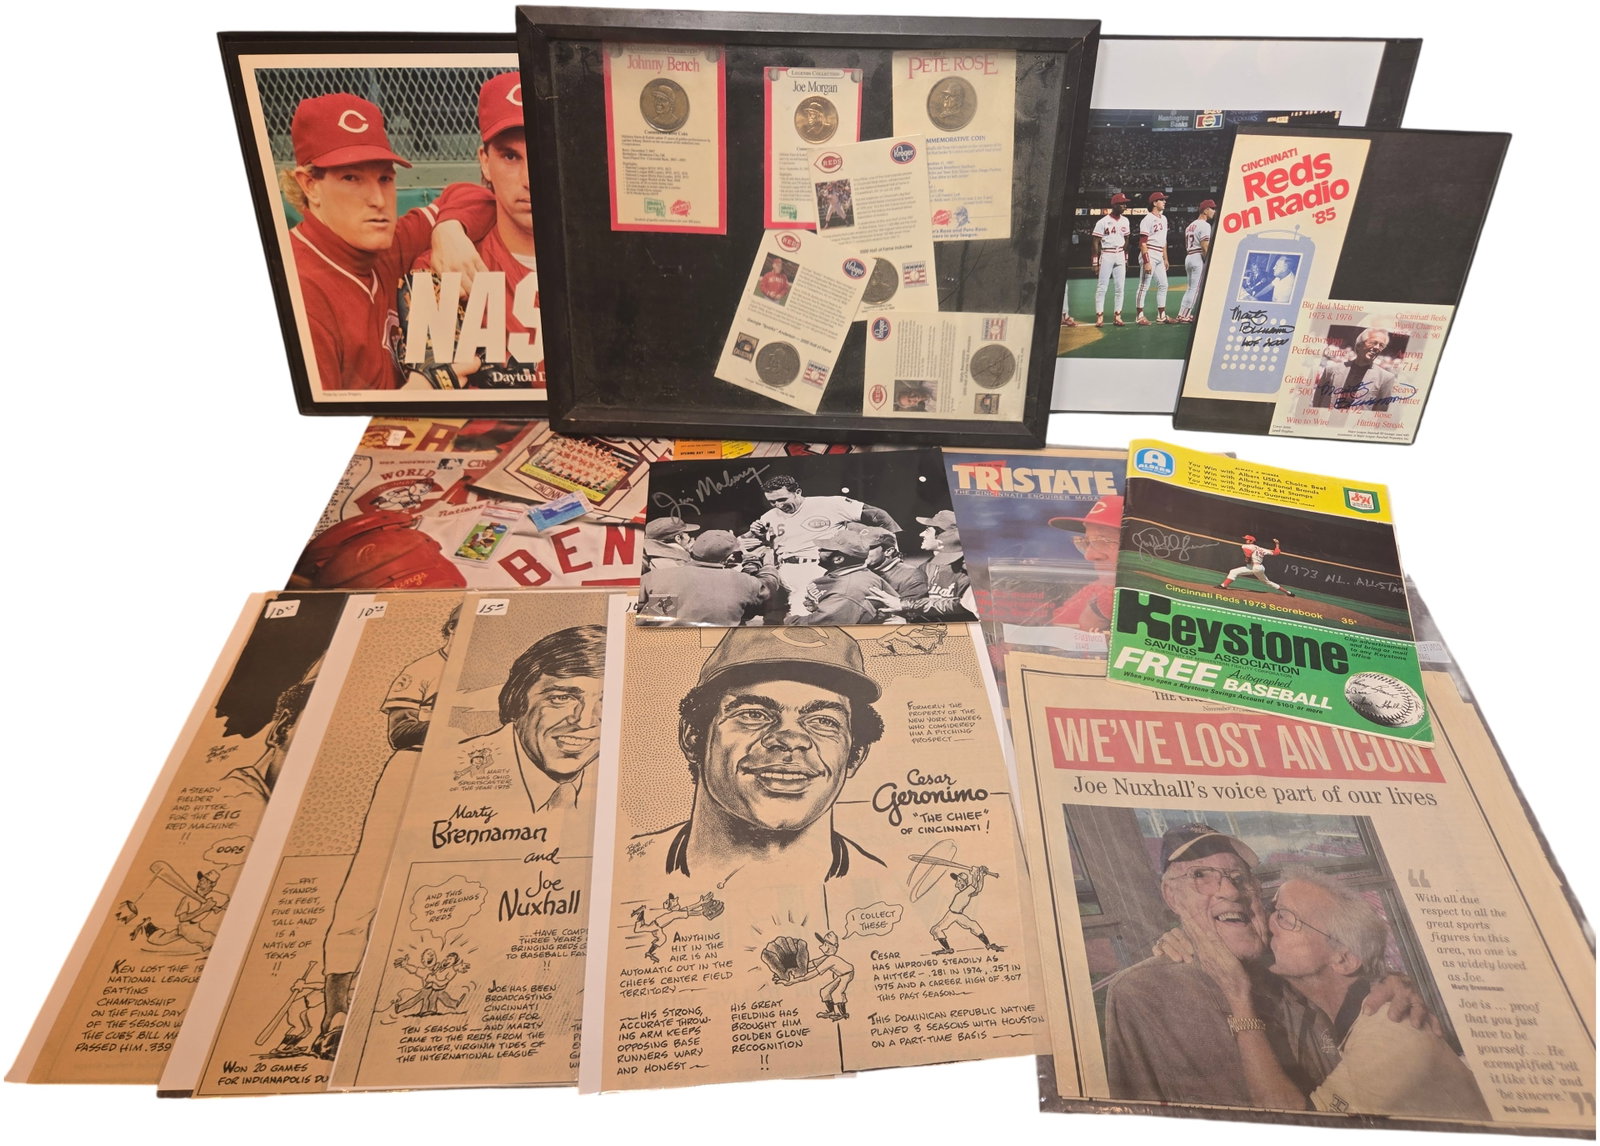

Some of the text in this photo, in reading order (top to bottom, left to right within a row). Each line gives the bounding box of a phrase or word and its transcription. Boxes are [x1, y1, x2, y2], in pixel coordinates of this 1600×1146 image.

[627, 54, 700, 74] Johnny Bench
[908, 54, 999, 80] PETE ROSE
[792, 81, 838, 95] Joe Morgan
[822, 158, 841, 166] REDS
[1241, 148, 1298, 173] CINCINNATI
[1242, 153, 1333, 202] Reds
[1223, 178, 1349, 234] on Radio
[1312, 207, 1336, 224] '85
[1104, 226, 1116, 235] 44
[1154, 223, 1163, 232] 23
[1302, 301, 1364, 311] Big Red Machine
[1309, 312, 1326, 320] 1975
[1292, 346, 1347, 357] Perfect Game
[492, 372, 537, 386] Dayton
[1285, 375, 1312, 386] Griffey
[1286, 416, 1303, 424] Wire
[1313, 417, 1329, 425] Wire
[1374, 411, 1392, 419] Rose
[1356, 419, 1404, 428] Hitting Streak
[381, 468, 436, 481] WORLD
[952, 465, 1118, 496] TRISTATE
[1263, 482, 1292, 490] National
[1296, 487, 1319, 495] Brands
[1285, 480, 1308, 488] Choice
[975, 490, 1024, 498] CINCINNATI
[1284, 564, 1319, 579] 1973
[1165, 583, 1214, 600] Cincinnati
[1216, 594, 1240, 604] Reds
[1243, 599, 1267, 610] 1973
[1269, 603, 1323, 620] Scorebook
[1116, 588, 1350, 675] Keystone
[1144, 639, 1197, 657] SAVINGS
[1113, 646, 1223, 688] FREE
[1214, 653, 1300, 676] ASSOCIATION
[1226, 669, 1292, 688] Autographed
[1223, 679, 1333, 710] BASEBALL
[1053, 716, 1172, 765] WE'VE
[1174, 722, 1269, 770] LOST
[1277, 723, 1332, 771] AN
[907, 769, 957, 786] Cesar
[1073, 775, 1438, 806] Joe Nuxhall's voice part of our lives
[872, 783, 989, 826] Geronimo
[213, 811, 241, 820] BIG
[450, 804, 498, 827] Marty
[913, 809, 989, 823] "THE CHIEF"
[166, 821, 237, 830] RED MACHINE
[432, 819, 547, 849] Brennaman
[216, 846, 245, 854] OOPS
[524, 848, 560, 864] and
[526, 871, 564, 898] Joe
[498, 887, 581, 922] Nuxhall
[1415, 893, 1479, 904] With all due
[860, 911, 896, 920] COLLECT
[1421, 907, 1506, 917] respect to all the
[860, 922, 888, 931] THESE
[1426, 920, 1490, 931] great sports
[673, 932, 721, 943] ANYTHING
[672, 944, 687, 952] HIT
[705, 941, 724, 950] THE
[670, 951, 718, 962] AIR IS AN
[620, 960, 733, 977] AUTOMATIC OUT IN THE
[660, 974, 698, 985] CENTER
[702, 971, 733, 981] FIELD
[488, 980, 507, 993] JOE
[620, 985, 676, 998] TERRITORY
[485, 993, 553, 1002] BROADCASTING
[484, 1004, 539, 1012] CINCINNATI
[730, 999, 783, 1012] HIS GREAT
[482, 1014, 514, 1022] GAMES
[731, 1008, 799, 1022] FIELDING HAS
[868, 1004, 1037, 1026] THIS DOMINICAN REPUBLIC NATIVE
[732, 1019, 802, 1031] BROUGHT HIM
[732, 1028, 811, 1042] GOLDEN GLOVE
[732, 1039, 803, 1054] RECOGNITION
[223, 1061, 308, 1074] WON 20 GAMES
